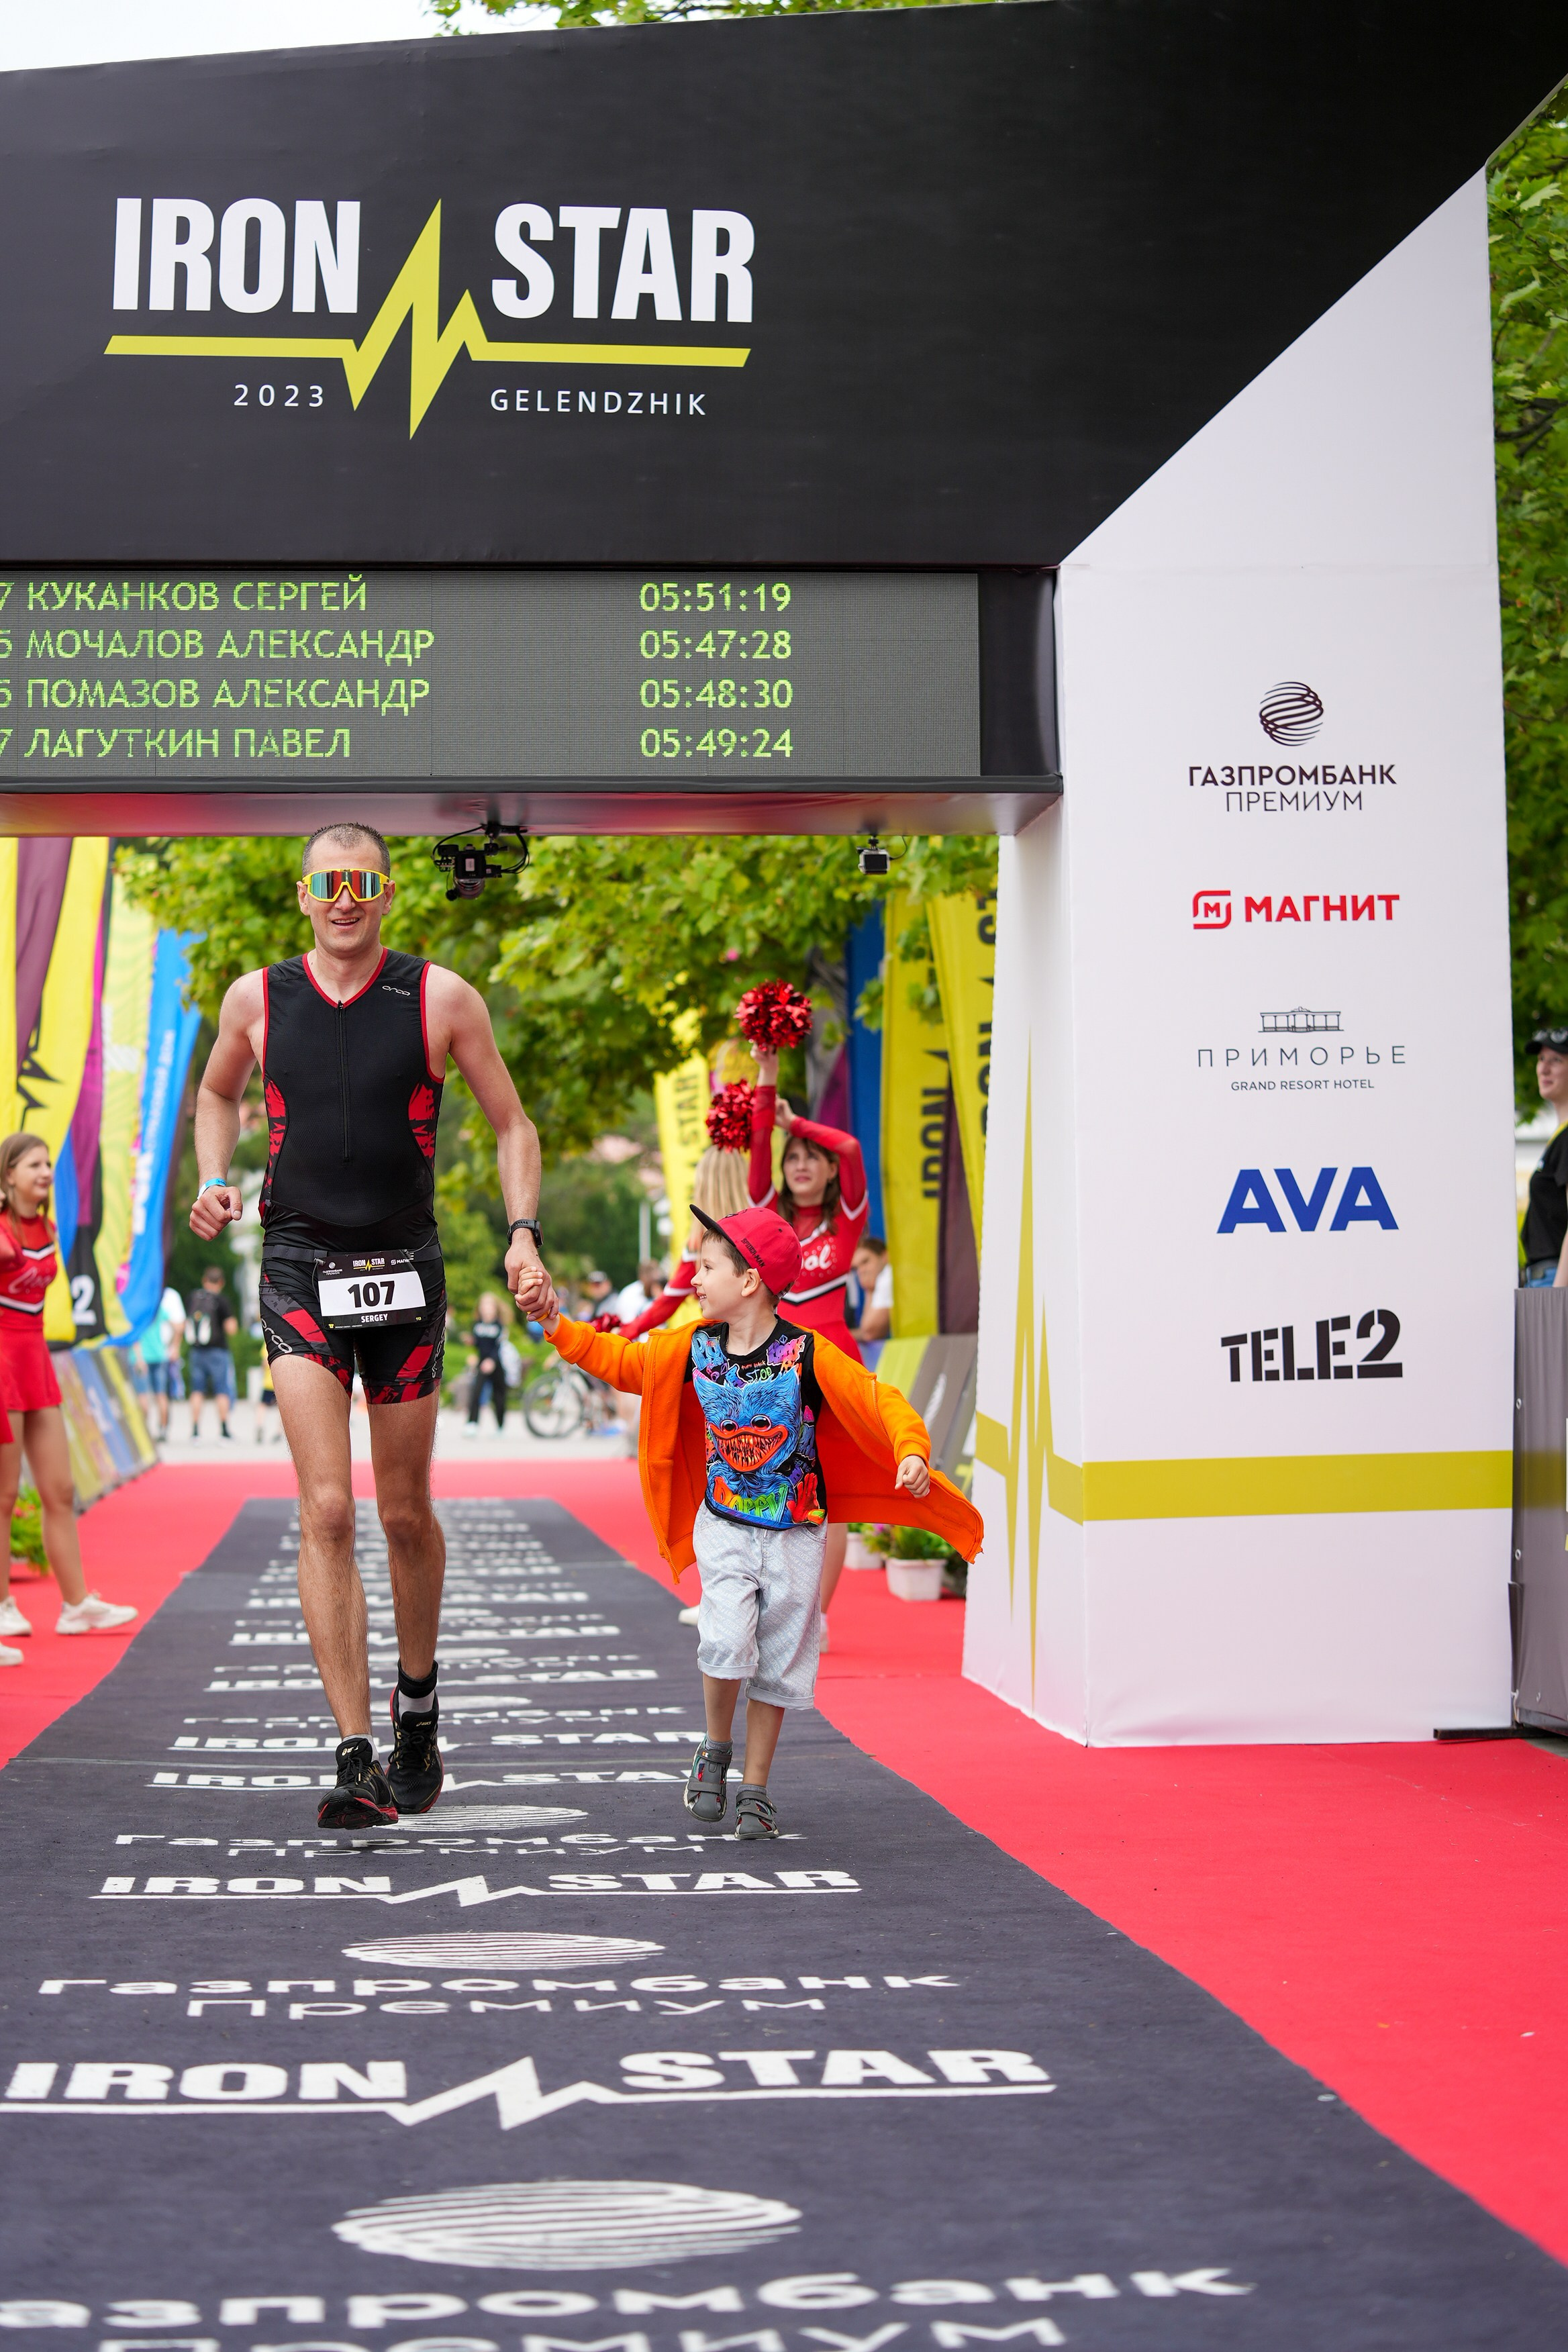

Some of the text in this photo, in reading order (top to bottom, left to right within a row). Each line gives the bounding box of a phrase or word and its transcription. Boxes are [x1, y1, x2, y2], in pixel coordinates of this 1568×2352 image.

[112, 197, 754, 323] IRON STAR
[234, 384, 707, 415] 2023 GELENDZHIK
[27, 582, 219, 611] КУКАНКОВ
[233, 574, 366, 611] СЕРГЕЙ
[640, 582, 792, 612] 05:51:19
[26, 630, 204, 658] МОЧАЛОВ
[217, 630, 434, 666] АЛЕКСАНДР
[640, 630, 792, 660] 05:47:28
[27, 679, 199, 709] ПОМАЗОВ
[213, 679, 430, 716] АЛЕКСАНДР
[640, 679, 793, 709] 05:48:30
[24, 729, 219, 758] ЛАГУТКИН
[234, 729, 350, 758] ПАВЕЛ
[640, 728, 793, 758] 05:49:24
[1188, 764, 1398, 787] ГАЗПРОМБАНК
[1226, 790, 1363, 812] ПРЕМИУМ
[1244, 894, 1400, 922] МАГНИТ
[381, 984, 411, 997] orca
[1197, 1045, 1407, 1068] ПРИМОРЬЕ
[1230, 1079, 1375, 1091] GRAND RESORT HOTEL
[1216, 1167, 1400, 1234] AVA
[352, 1257, 385, 1267] IRON STAR
[347, 1281, 395, 1308] 107
[360, 1313, 389, 1323] SERGEY
[1220, 1308, 1404, 1383] TELE2
[101, 1870, 860, 1894] IRON STAR
[38, 1975, 961, 1997] Газпромбанк
[187, 1998, 826, 2021] Премиум
[4, 2049, 1051, 2100] IRON STAR
